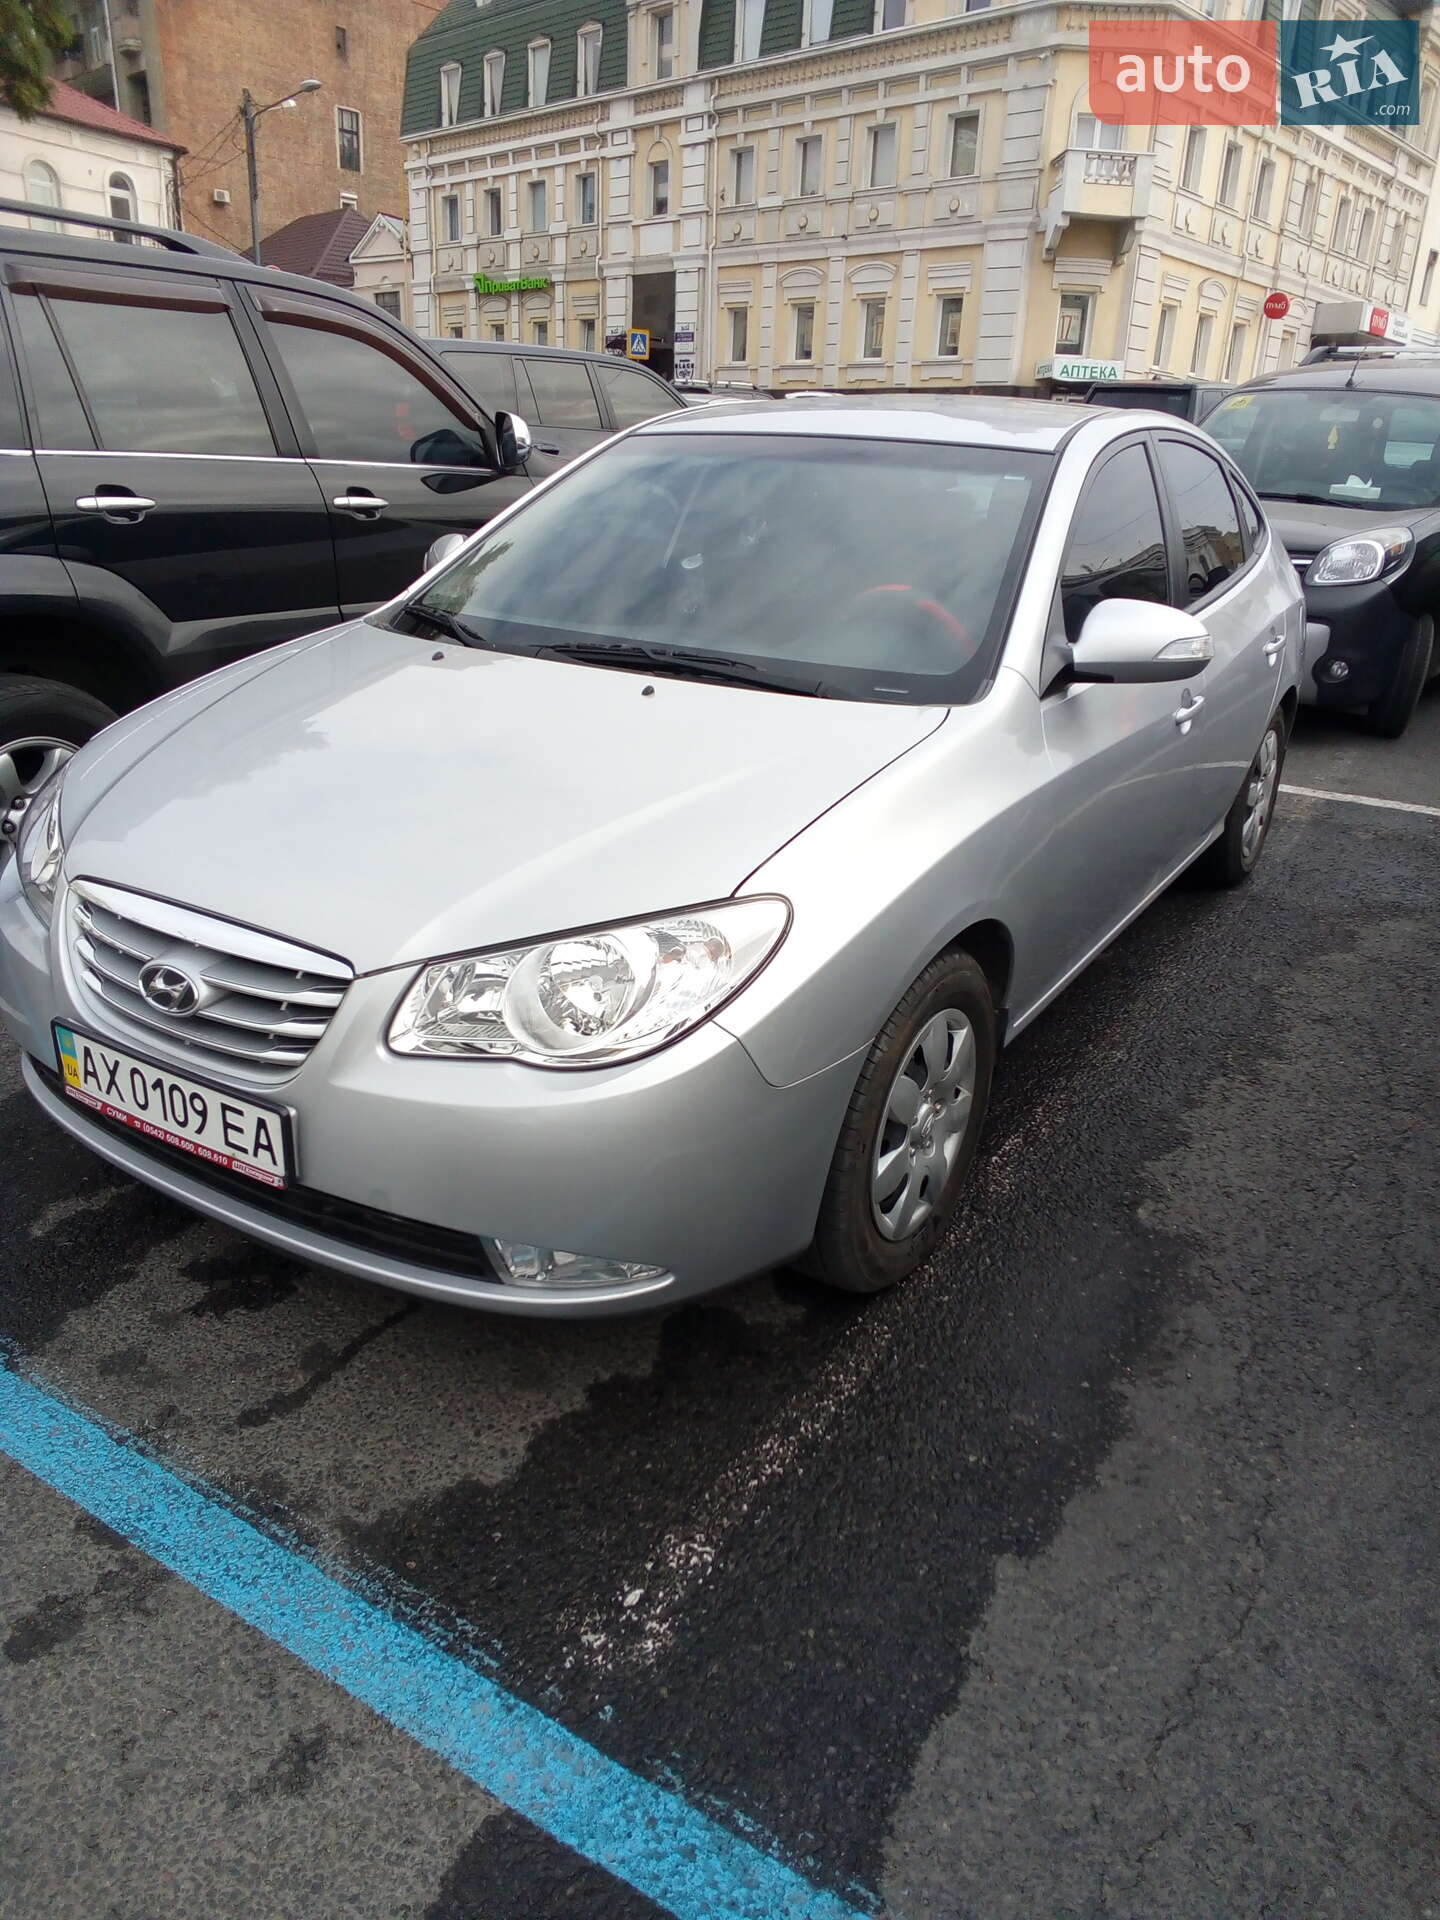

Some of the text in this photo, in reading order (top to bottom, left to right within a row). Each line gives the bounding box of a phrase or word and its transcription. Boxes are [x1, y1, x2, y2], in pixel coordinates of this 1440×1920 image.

[1060, 364, 1117, 379] АПТЕКА
[67, 1063, 79, 1079] UA
[83, 1046, 278, 1166] AX 0109 EA
[143, 1123, 164, 1140] (0542)
